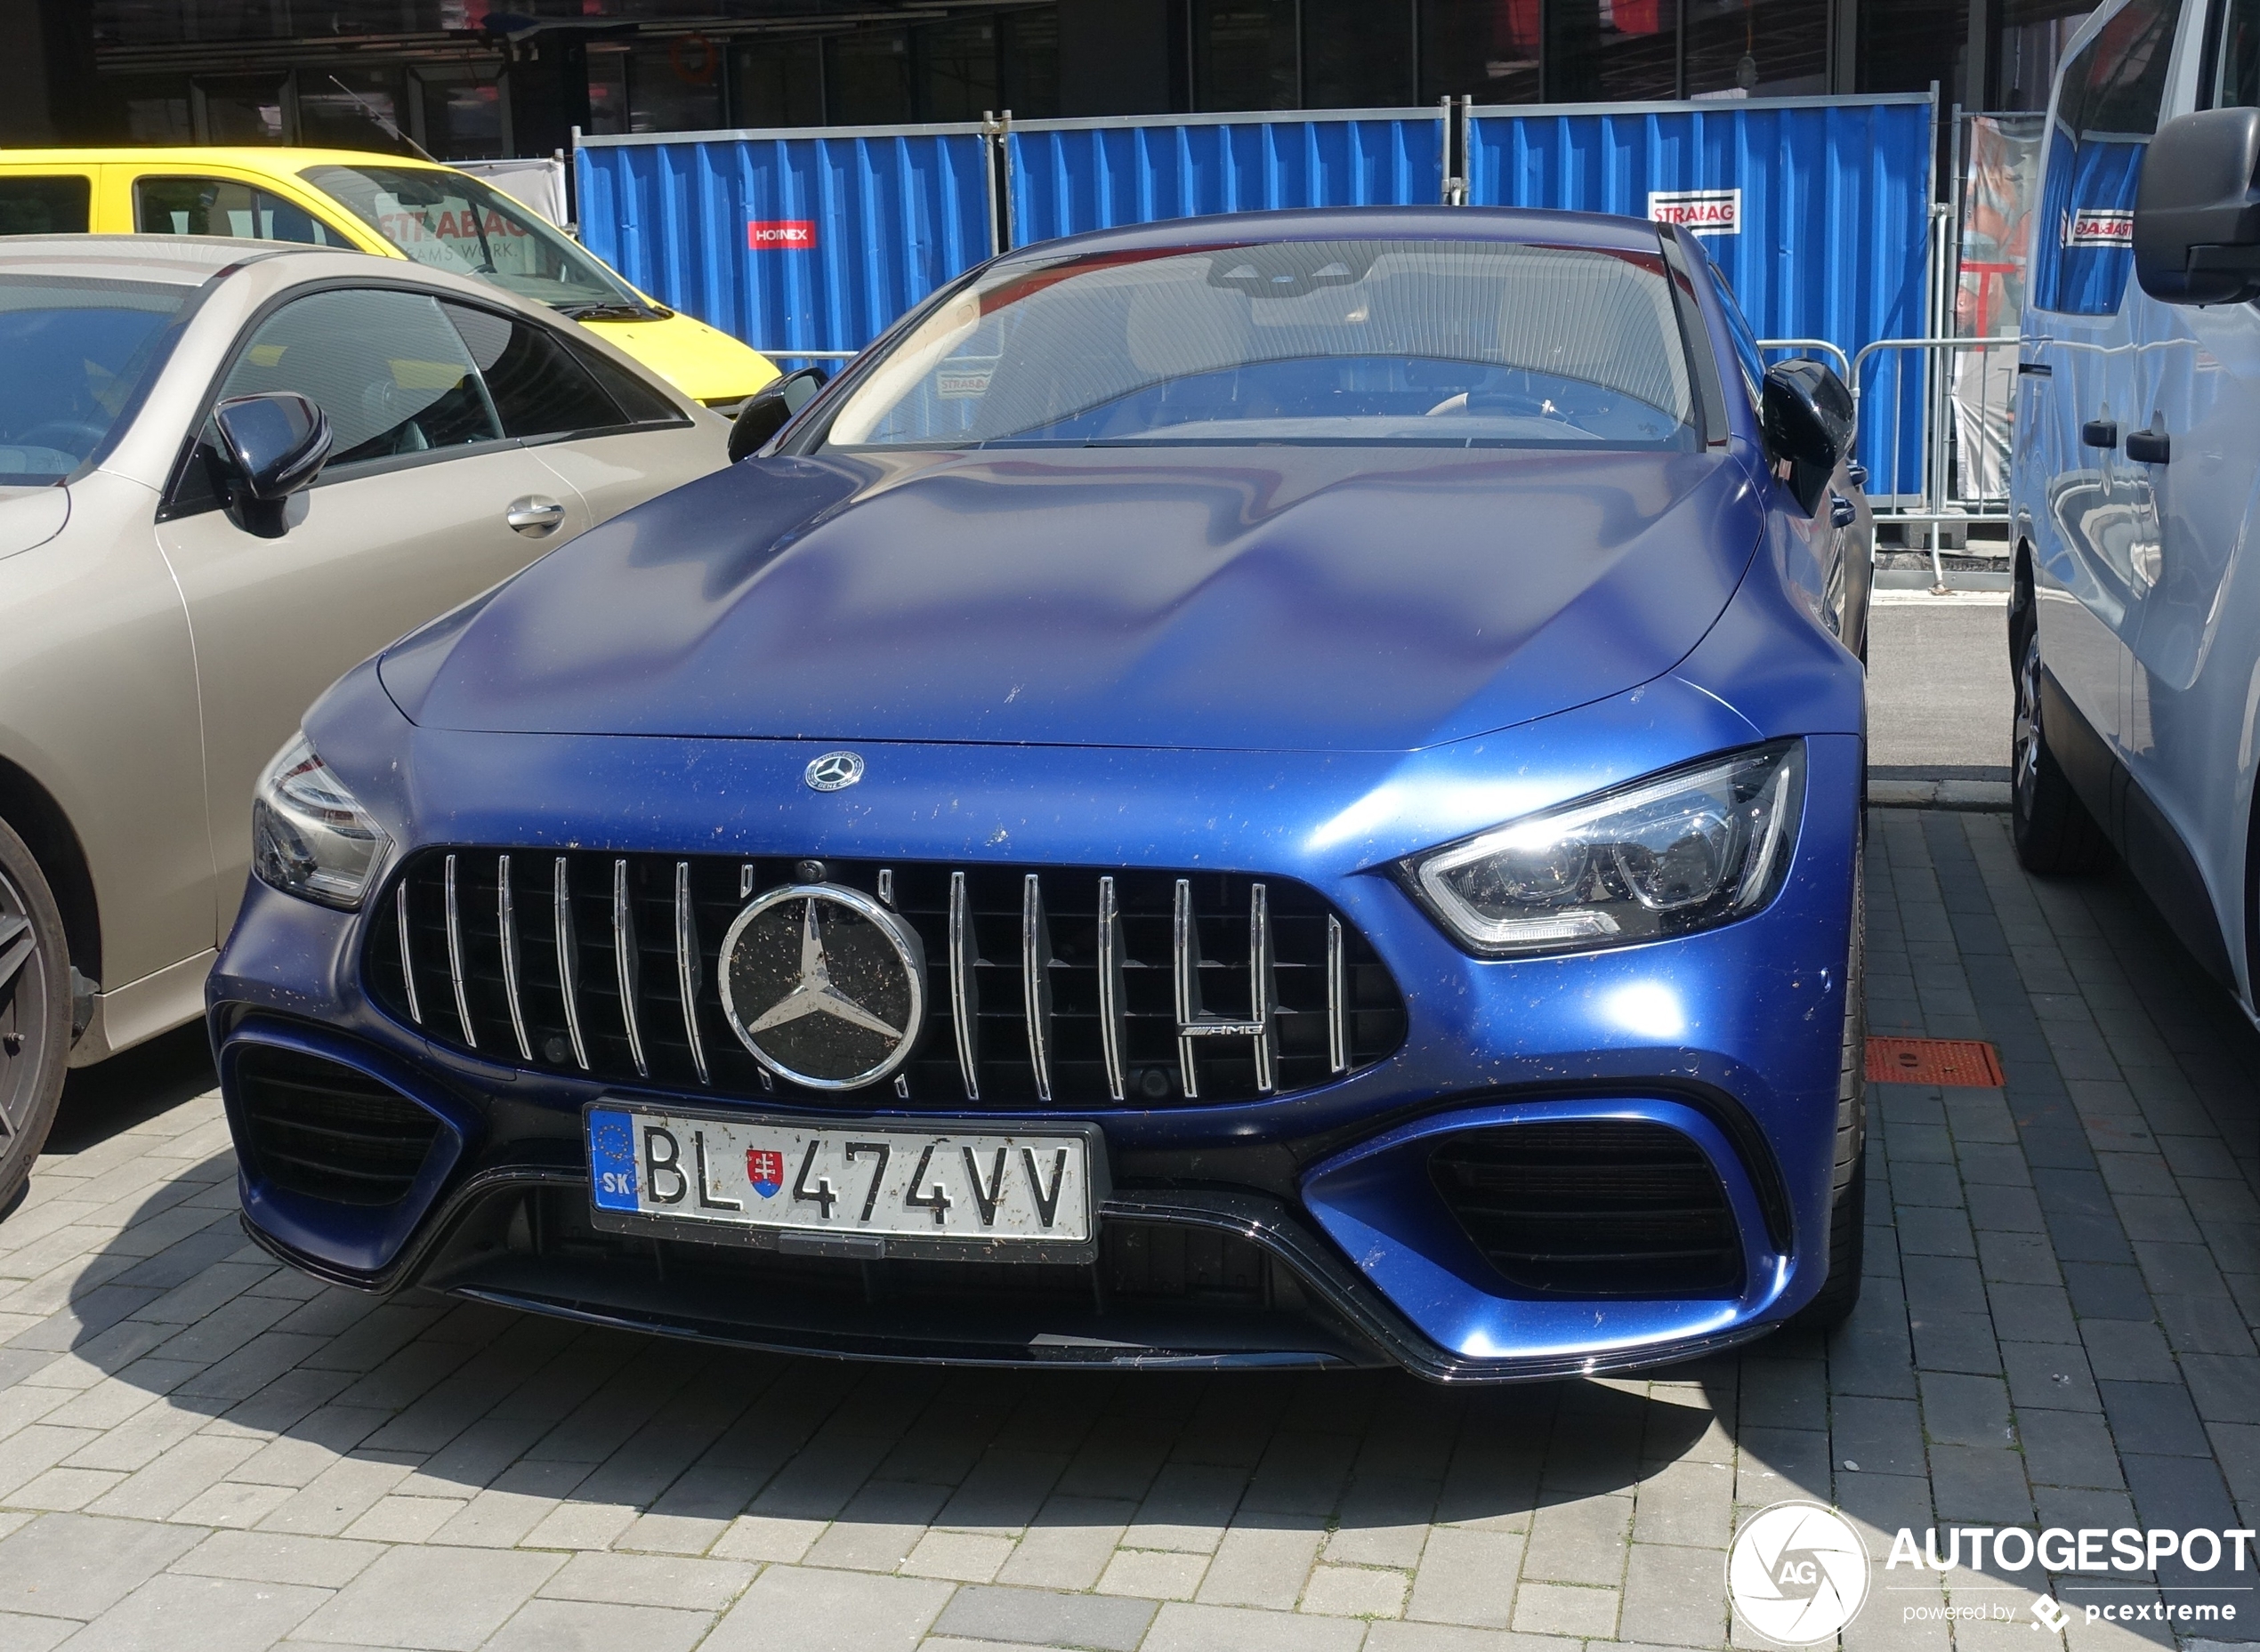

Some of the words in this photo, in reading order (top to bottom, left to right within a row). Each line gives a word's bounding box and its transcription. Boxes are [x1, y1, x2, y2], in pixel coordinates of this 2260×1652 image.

[1655, 205, 1734, 223] STRABAG
[406, 246, 454, 262] EAMS
[1207, 1025, 1263, 1036] AMG
[603, 1172, 634, 1196] SK
[644, 1125, 744, 1211] BL
[792, 1140, 1069, 1228] 474VV
